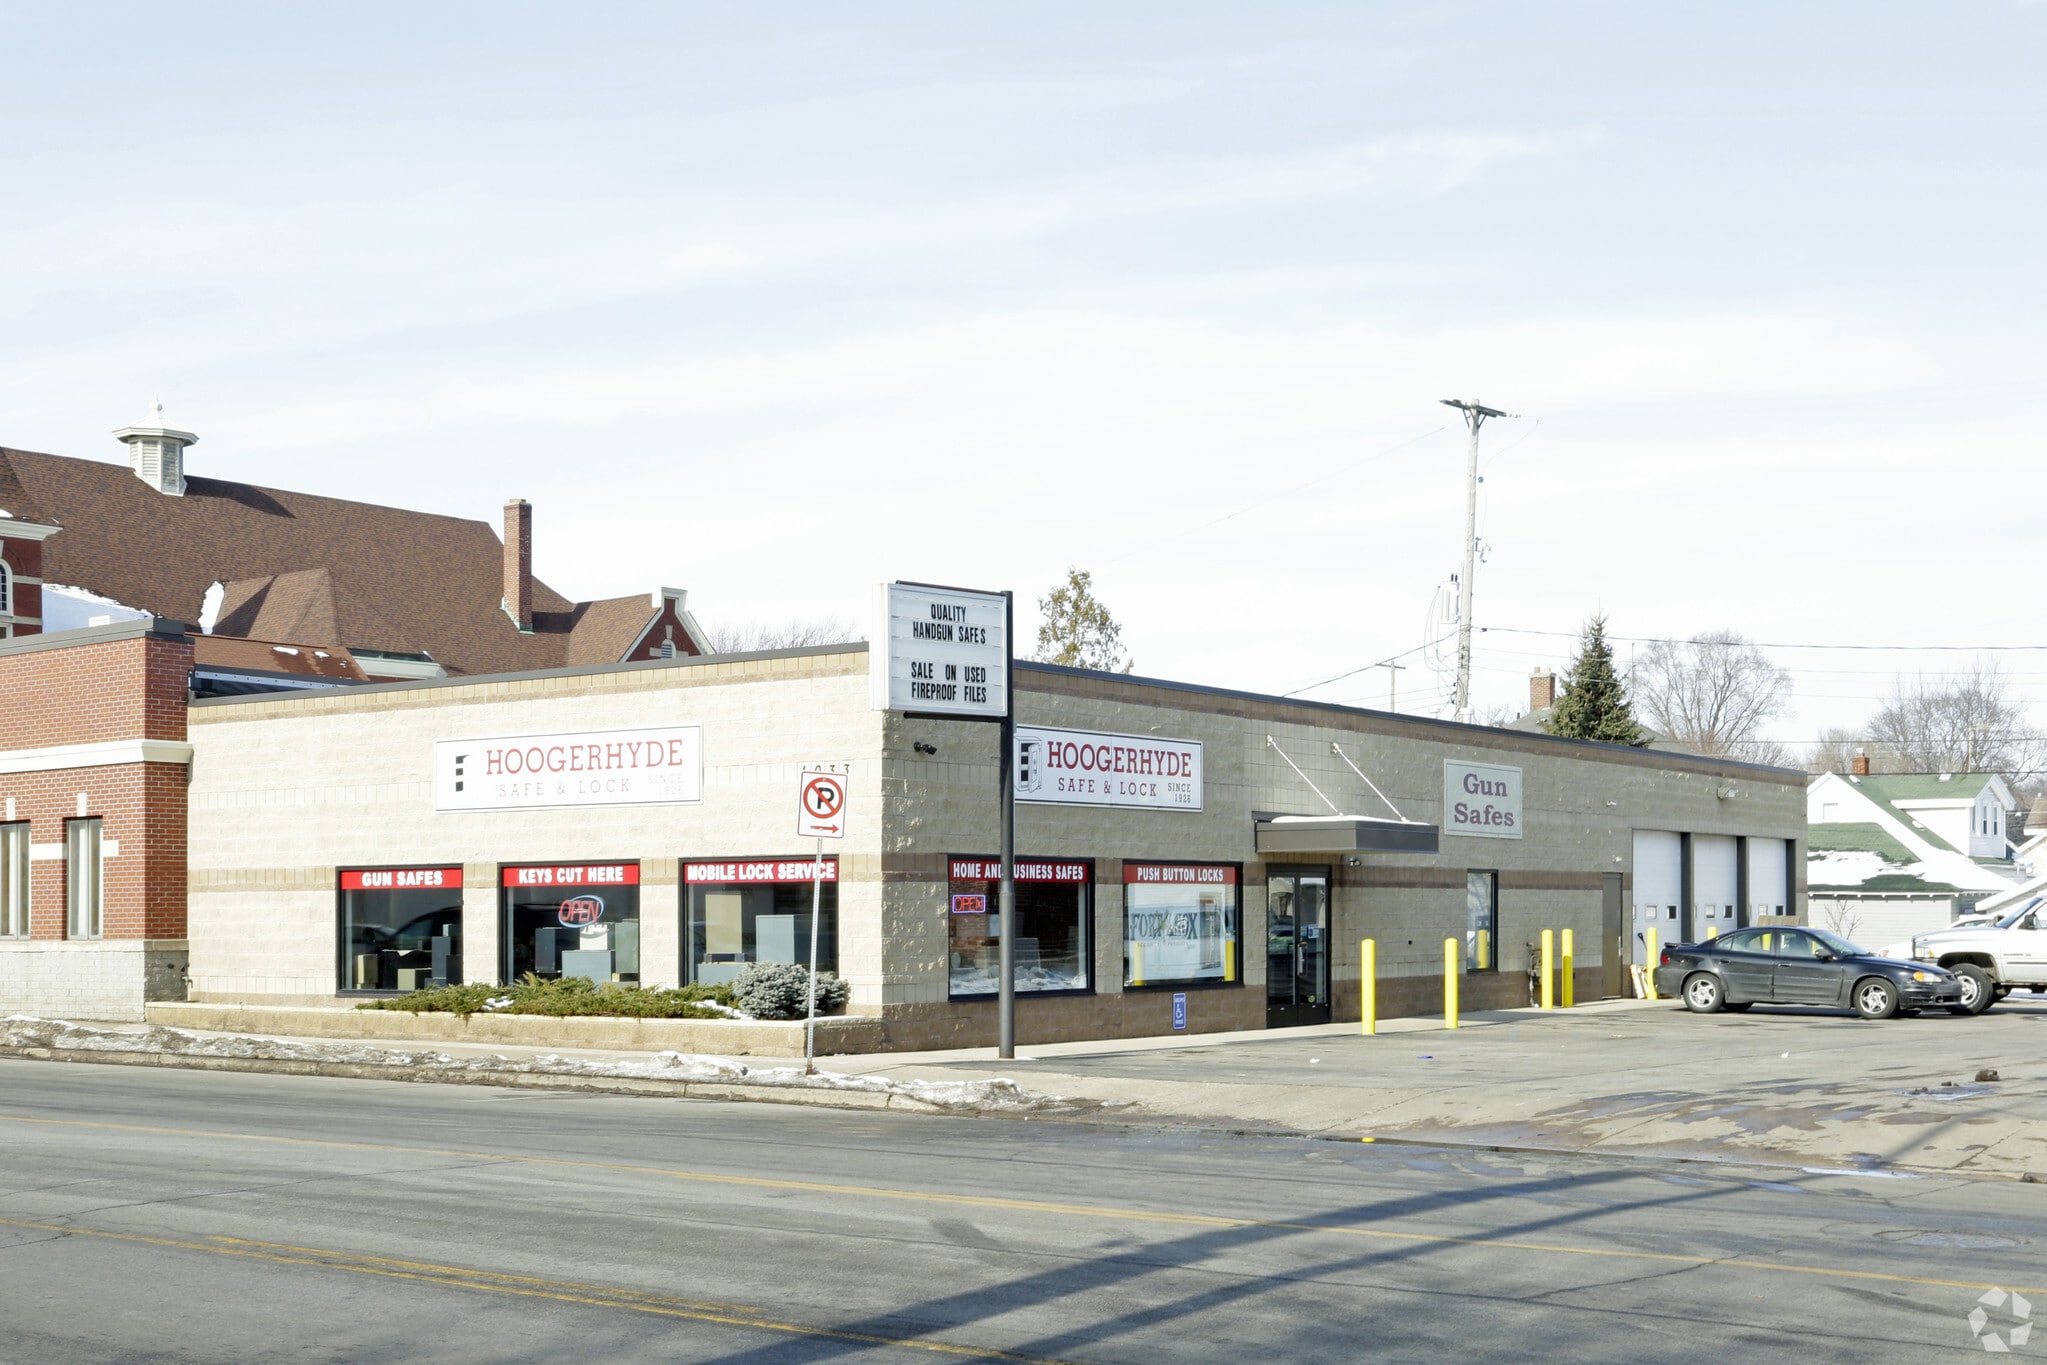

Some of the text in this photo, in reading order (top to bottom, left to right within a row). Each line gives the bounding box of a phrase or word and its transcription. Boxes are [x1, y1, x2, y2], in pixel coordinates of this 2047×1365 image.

[930, 603, 967, 622] QUALITY
[912, 621, 986, 644] HANDGUN SAFES
[911, 661, 986, 683] SALE ON USED
[911, 682, 987, 703] FIREPROOF FILES
[486, 739, 683, 775] HOOGERHYDE
[1047, 741, 1192, 777] HOOGERHYDE
[499, 778, 631, 798] SAFE & LOCK
[1058, 777, 1157, 797] SAFE & LOCK
[1167, 782, 1192, 793] SINCE
[1463, 772, 1508, 797] Gun
[1174, 793, 1192, 804] 1926
[1454, 801, 1515, 827] Safes
[361, 870, 443, 887] GUN SAFES
[518, 866, 624, 884] KEYS CUT HERE
[687, 862, 835, 881] MOBILE LOCK SERVICE
[953, 862, 982, 879] HOME
[1013, 864, 1053, 880] USINESS
[1055, 865, 1084, 880] SAFES
[1137, 867, 1224, 882] PUSH BUTTON LOCKS
[560, 898, 600, 922] OPEN
[954, 895, 983, 912] OPEN
